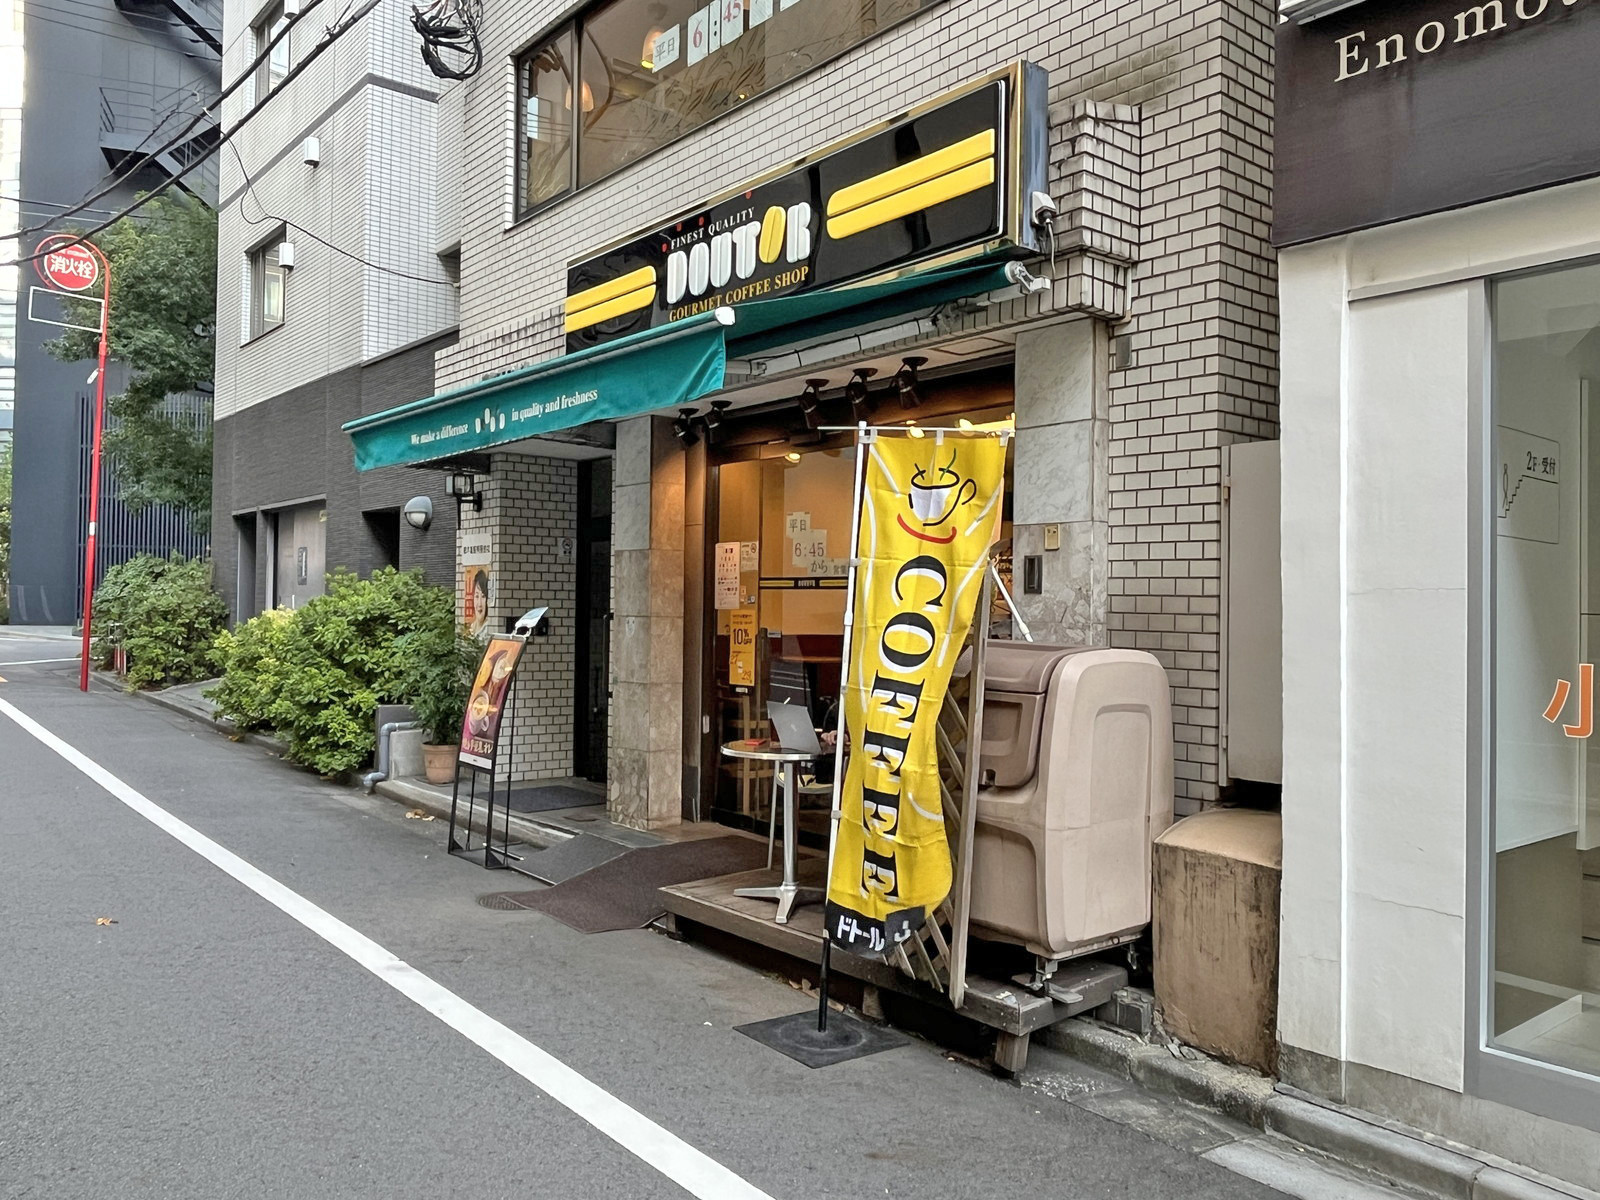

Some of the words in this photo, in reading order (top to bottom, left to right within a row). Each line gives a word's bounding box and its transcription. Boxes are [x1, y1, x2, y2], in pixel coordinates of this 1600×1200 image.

[654, 37, 675, 61] 平日
[1333, 0, 1579, 82] Enomo
[671, 227, 705, 250] FINEST
[708, 207, 755, 236] QUALITY
[50, 253, 94, 279] 消火栓
[667, 202, 811, 304] DOUTOR
[669, 294, 722, 322] GOURMET
[725, 278, 771, 305] COFFEE
[774, 266, 809, 290] SHOP
[410, 433, 420, 445] We
[420, 430, 435, 443] make
[440, 423, 469, 439] difference
[511, 407, 519, 421] in
[519, 402, 544, 423] quality
[545, 397, 560, 413] and
[561, 389, 598, 409] freshness
[788, 518, 807, 532] 平日
[794, 542, 825, 557] 6:45
[810, 561, 828, 574] から
[860, 555, 948, 903] COFFEE
[836, 914, 885, 952] ドトール
